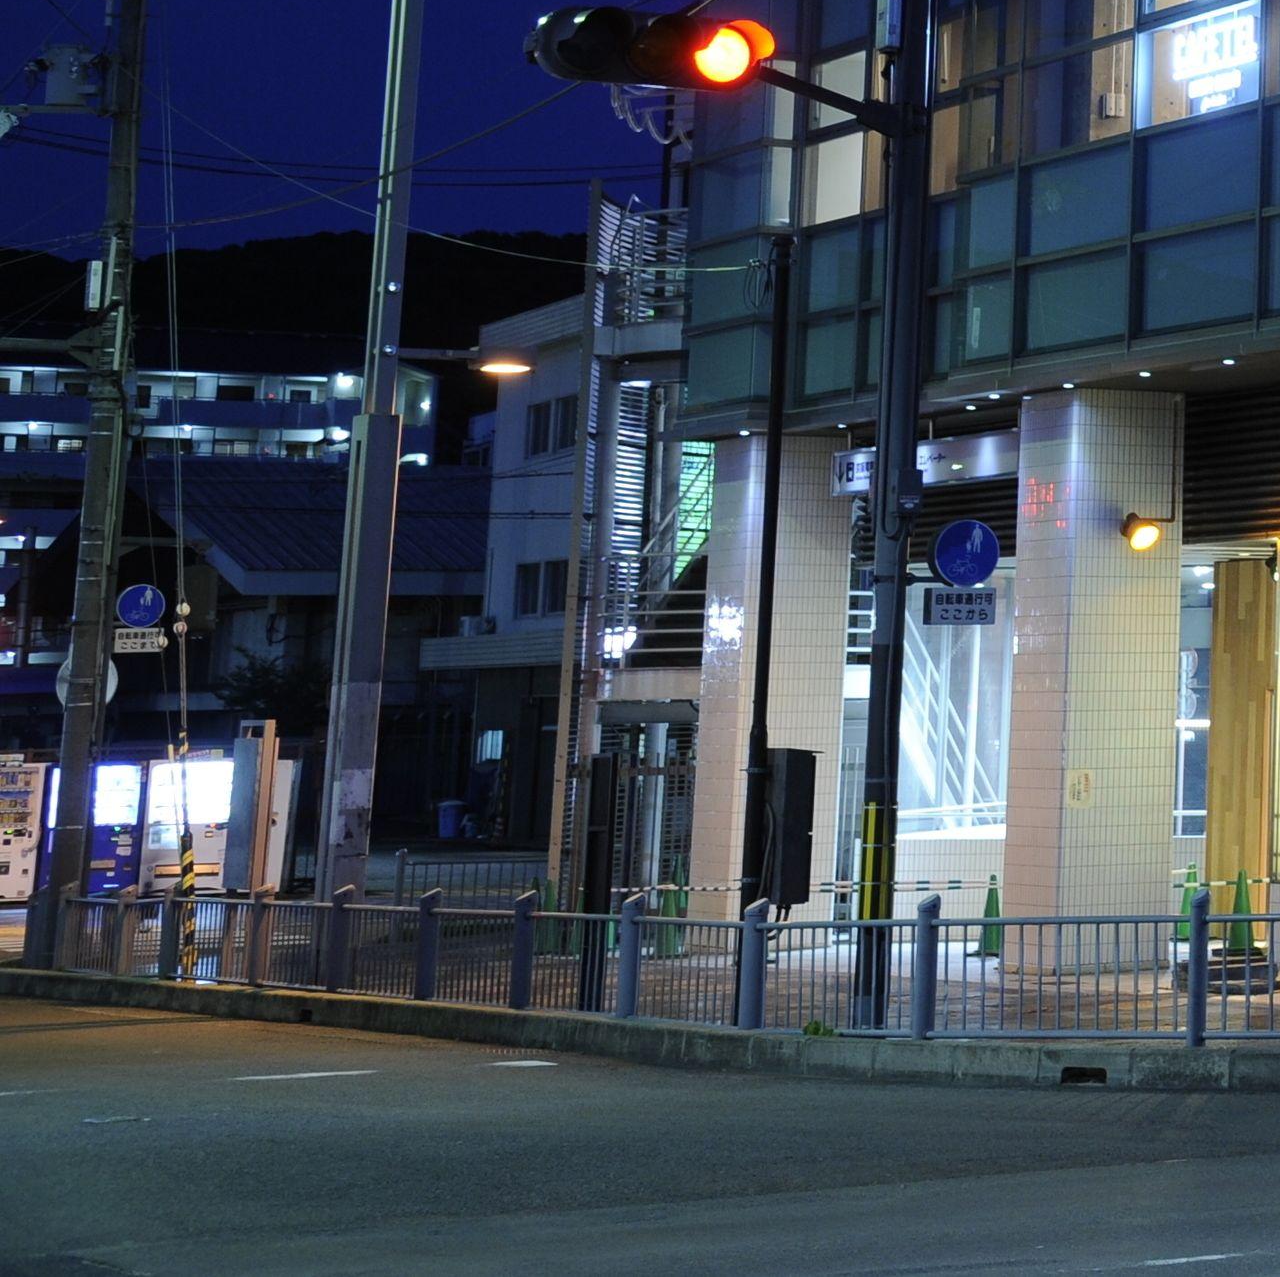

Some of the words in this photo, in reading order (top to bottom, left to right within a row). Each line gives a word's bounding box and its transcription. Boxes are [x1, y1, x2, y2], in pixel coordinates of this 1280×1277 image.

[936, 593, 993, 605] 自転車通行可
[940, 609, 988, 620] ここから
